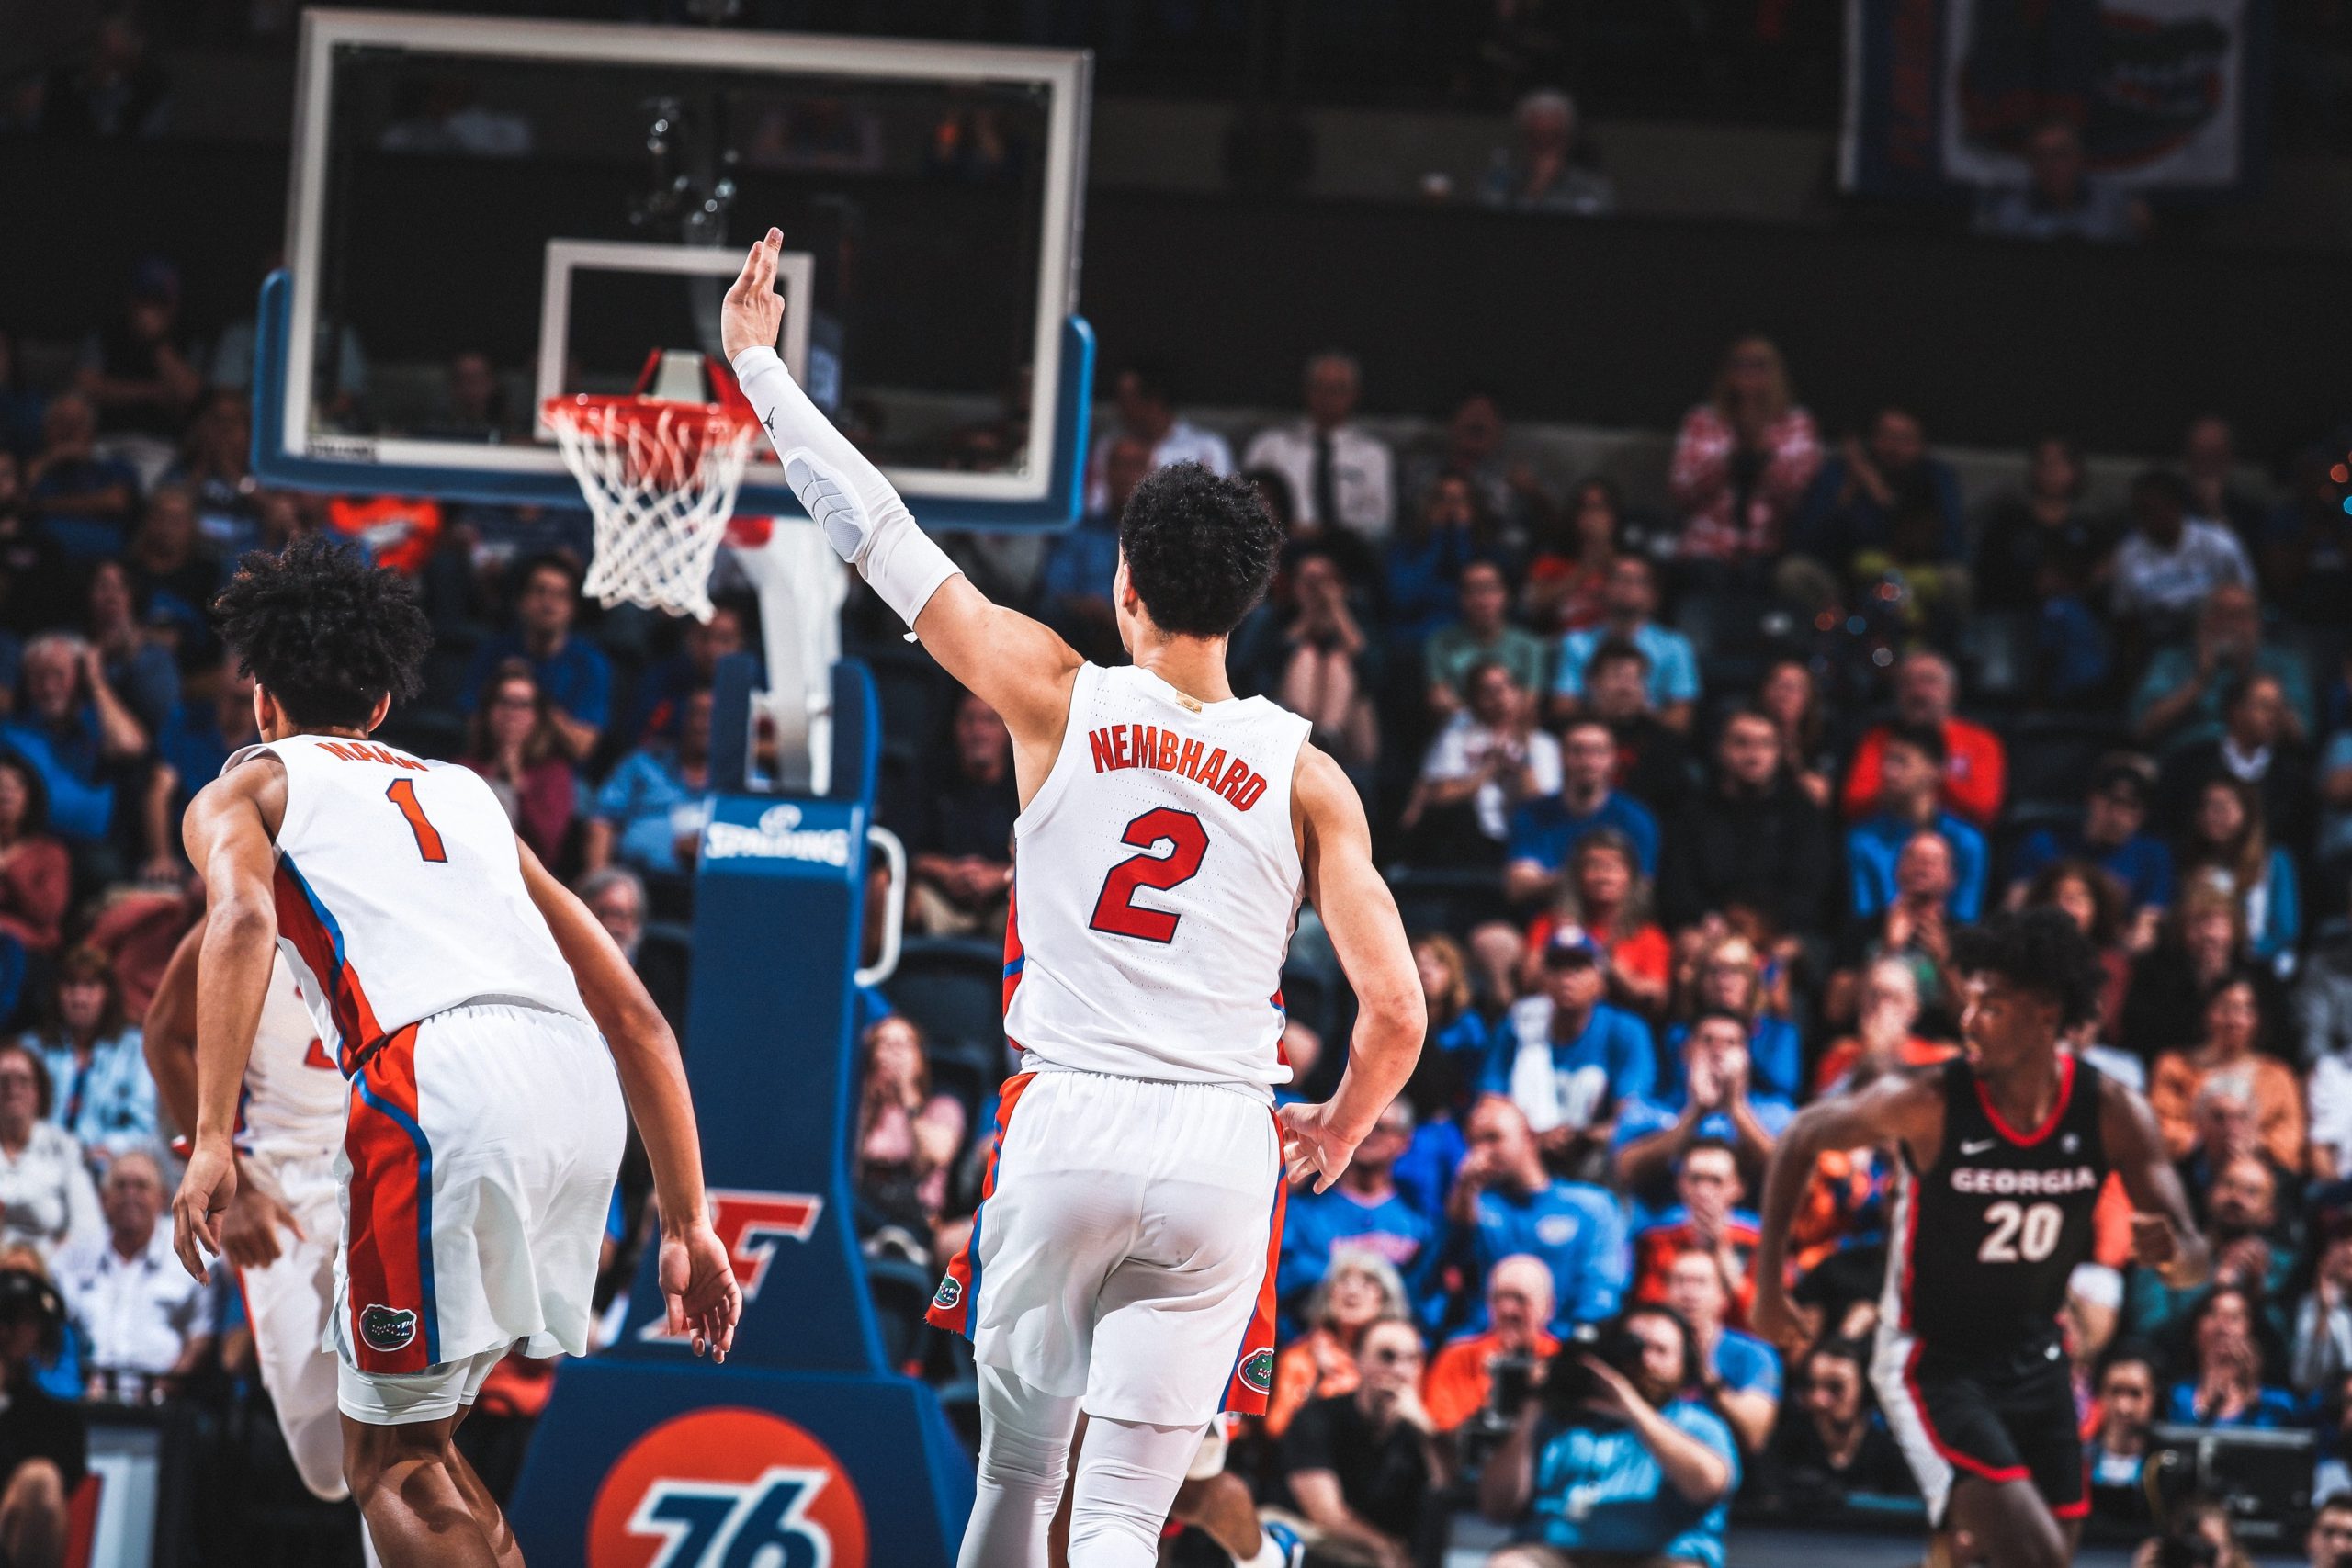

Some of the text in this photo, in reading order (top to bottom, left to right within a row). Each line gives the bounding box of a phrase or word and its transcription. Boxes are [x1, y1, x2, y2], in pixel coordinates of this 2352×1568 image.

[1088, 724, 1268, 812] NEMBHARD
[385, 778, 448, 863] 1
[705, 821, 850, 867] SPALDING
[1089, 806, 1211, 944] 2
[1951, 1166, 2097, 1194] GEORGIA
[1977, 1200, 2064, 1263] 20
[626, 1467, 832, 1568] 76
